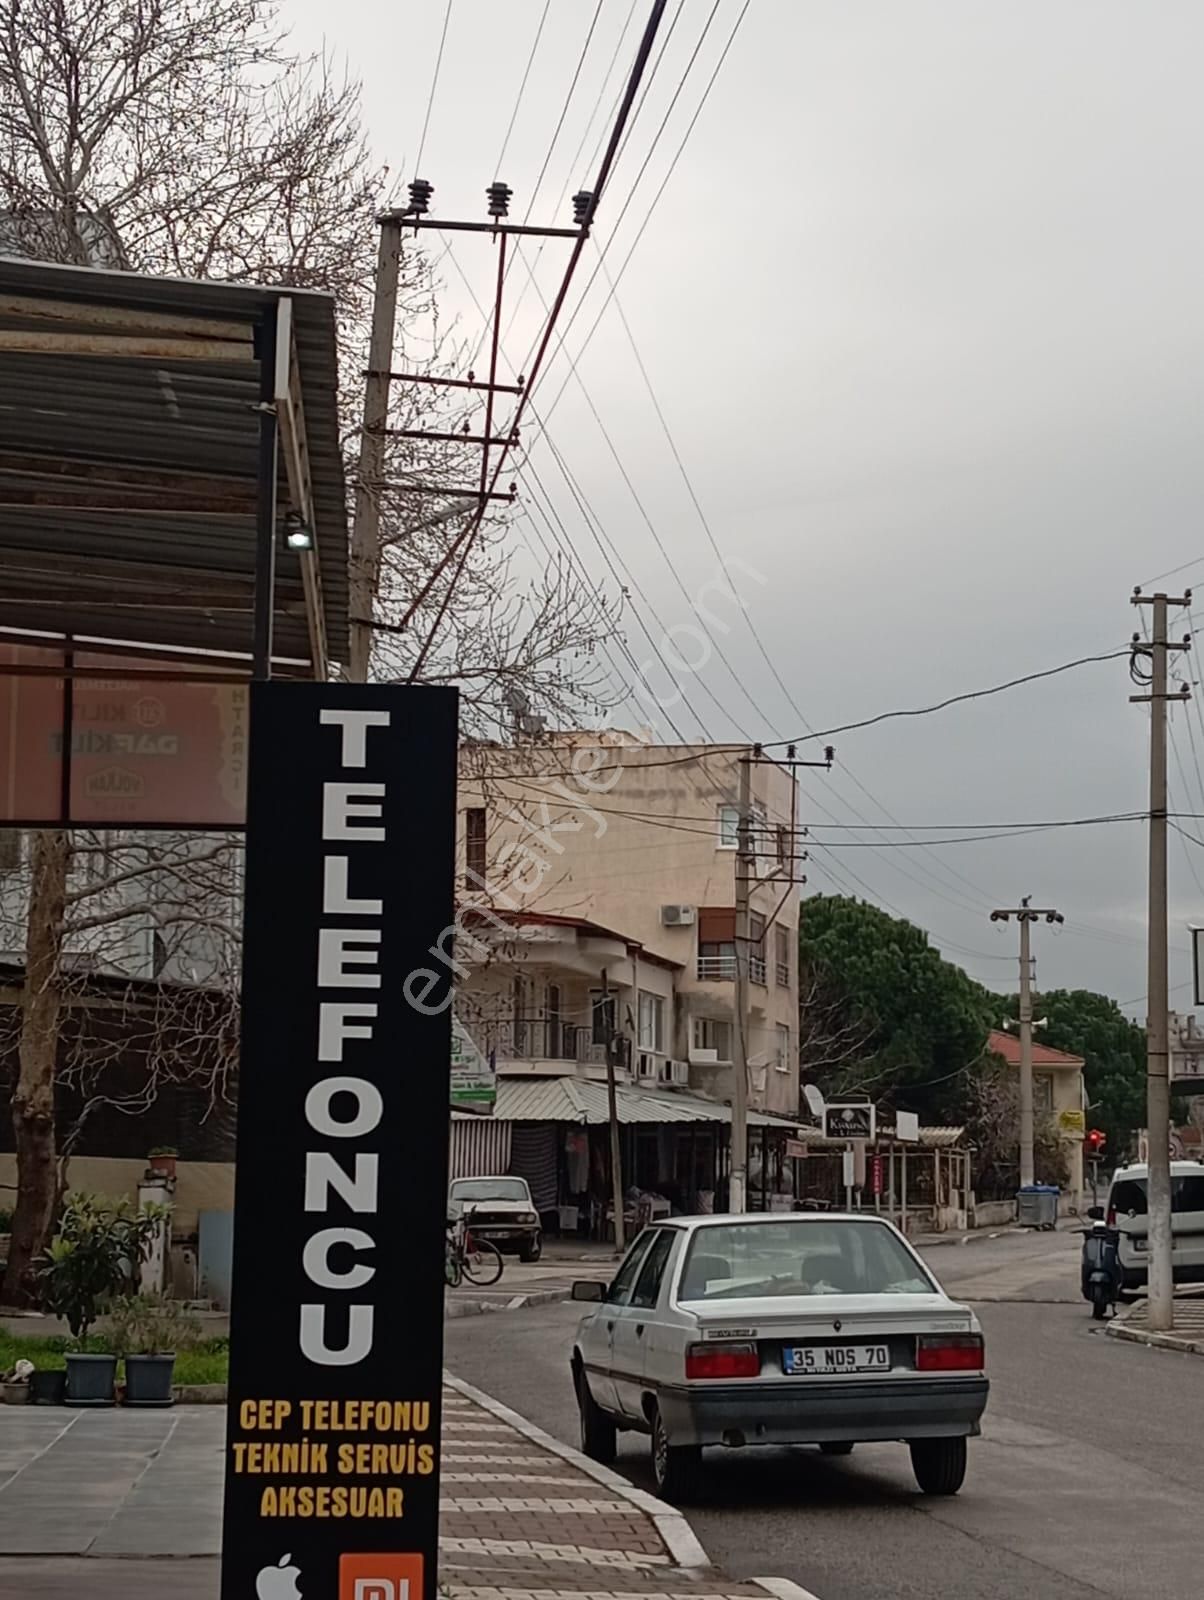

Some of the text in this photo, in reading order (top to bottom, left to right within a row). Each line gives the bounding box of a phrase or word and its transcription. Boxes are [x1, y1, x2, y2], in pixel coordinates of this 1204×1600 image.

[299, 709, 391, 1366] TELEFONCU
[794, 1347, 887, 1367] 35 NDS 70
[240, 1399, 430, 1431] CEP TELEFONU
[233, 1437, 434, 1474] TEKNİK SERVİS
[260, 1486, 404, 1518] AKSESUAR
